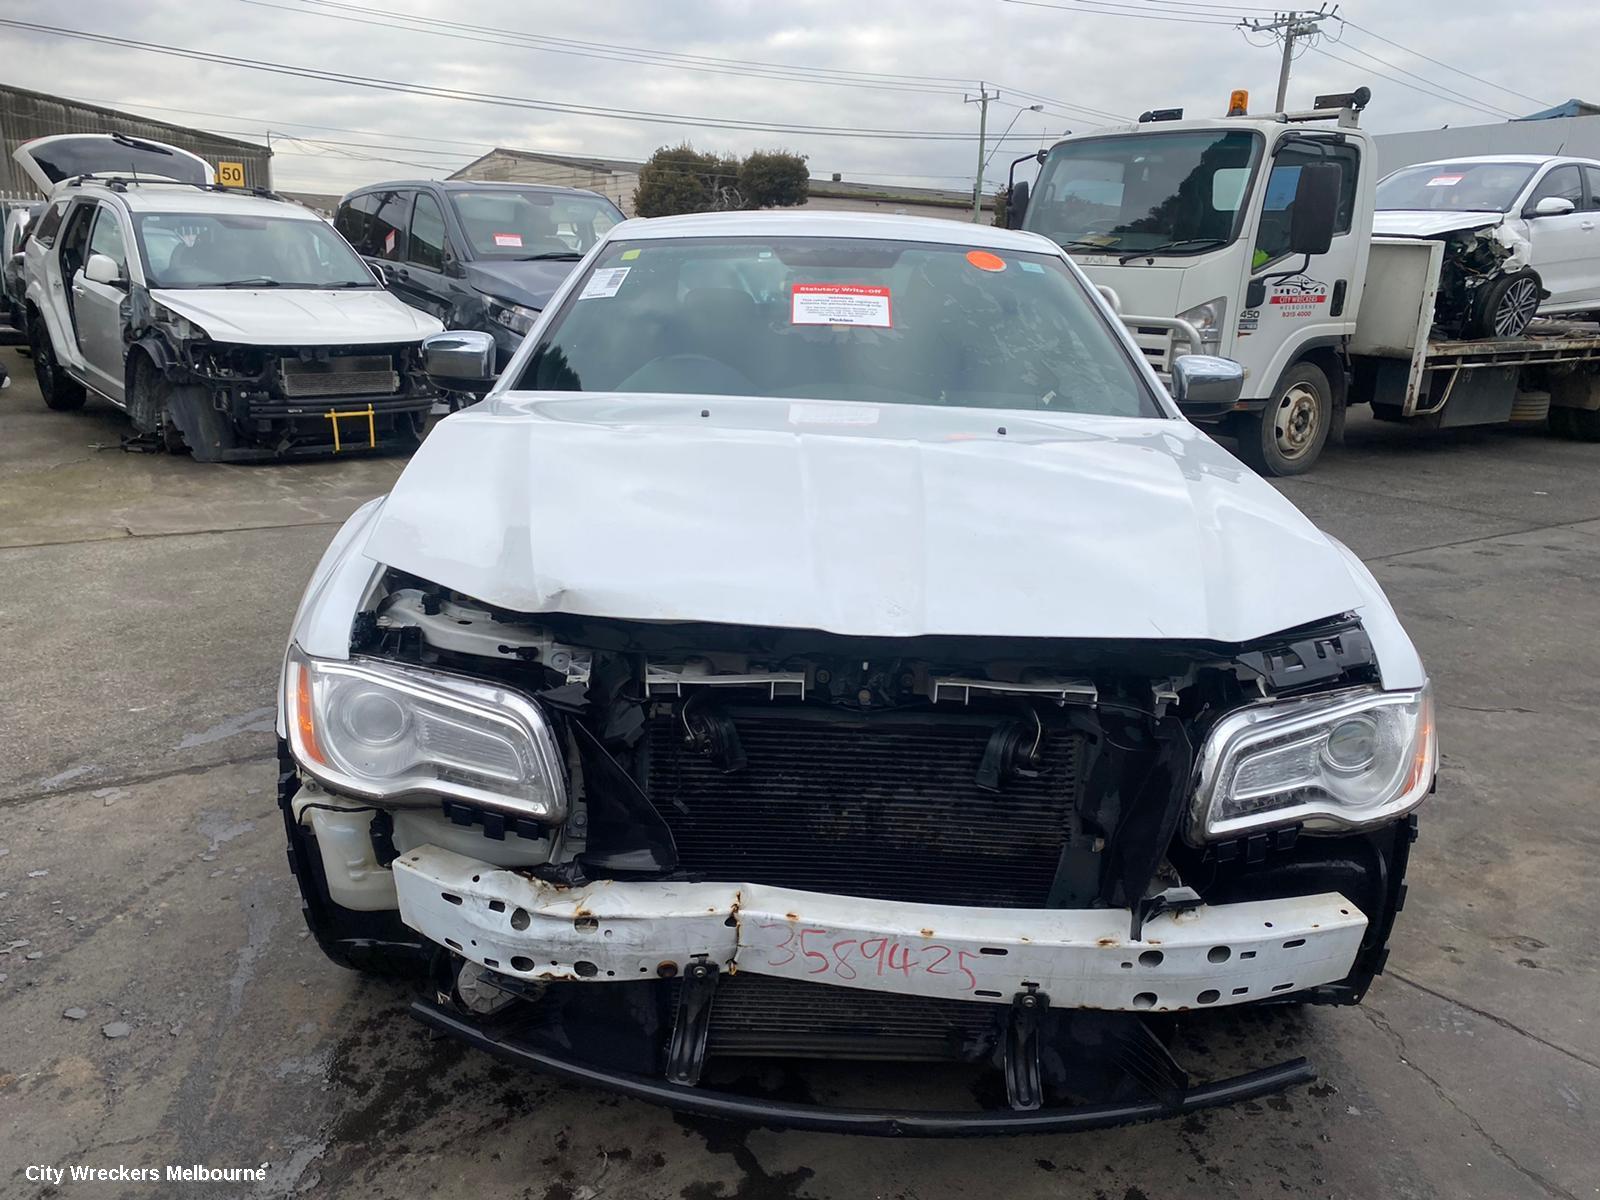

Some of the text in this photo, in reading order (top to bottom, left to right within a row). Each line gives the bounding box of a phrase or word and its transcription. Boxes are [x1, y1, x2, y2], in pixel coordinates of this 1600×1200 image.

[222, 167, 241, 182] 50
[1240, 310, 1260, 319] 450
[759, 924, 978, 991] 3589425
